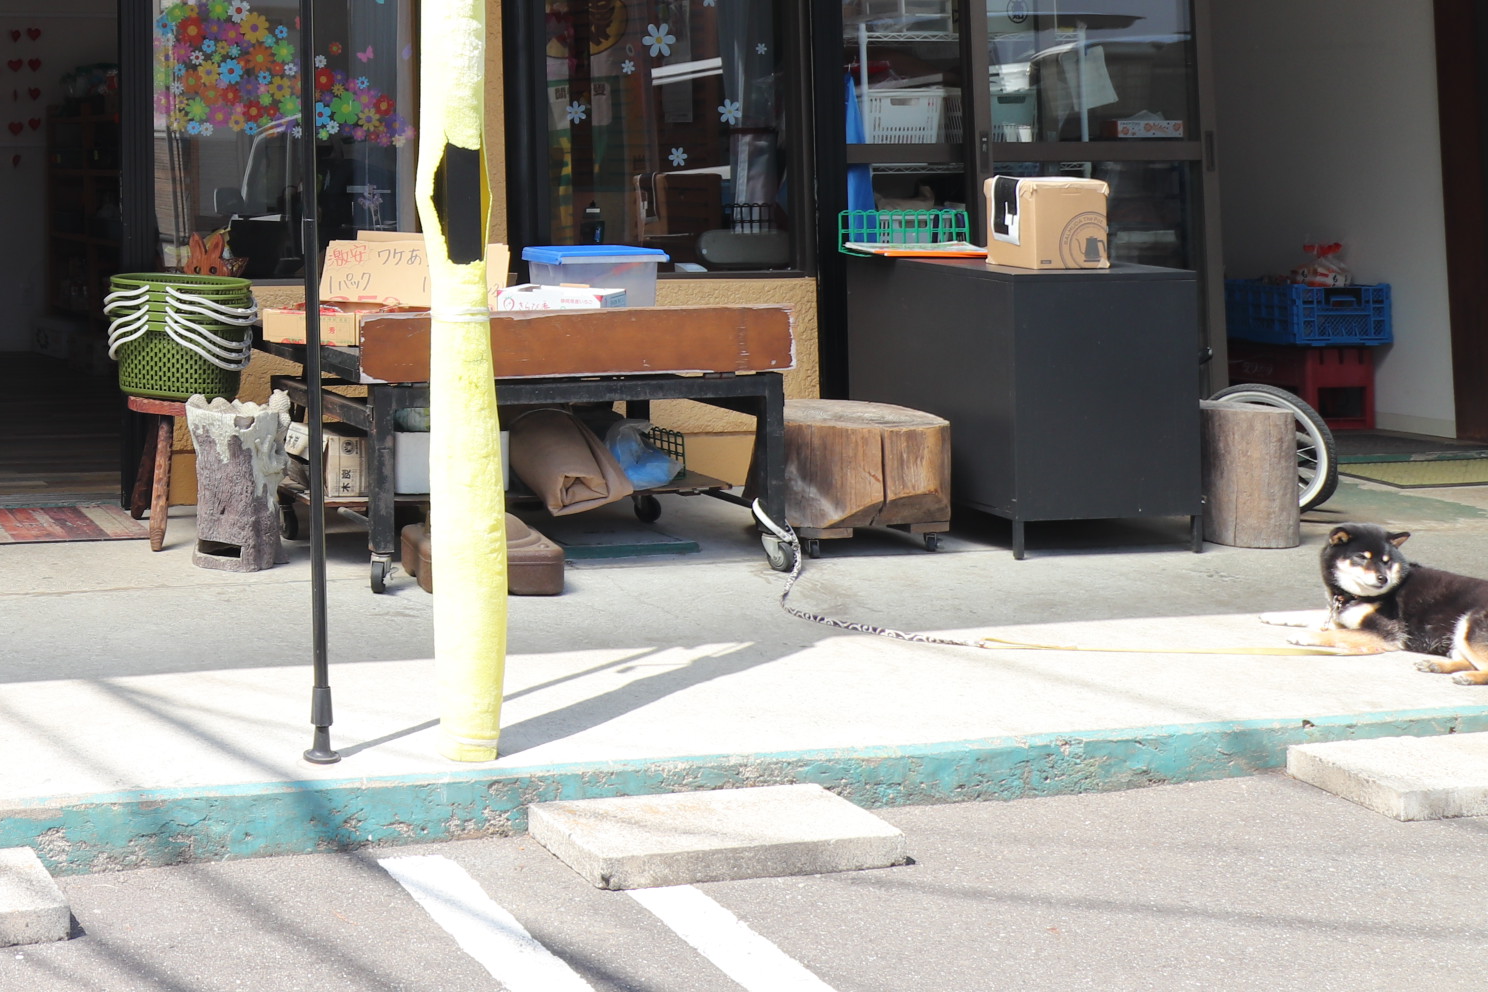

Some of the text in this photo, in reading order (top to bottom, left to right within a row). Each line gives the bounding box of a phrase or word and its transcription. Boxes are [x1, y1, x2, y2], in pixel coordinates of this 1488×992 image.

[328, 244, 430, 268] 激安 ワケあ
